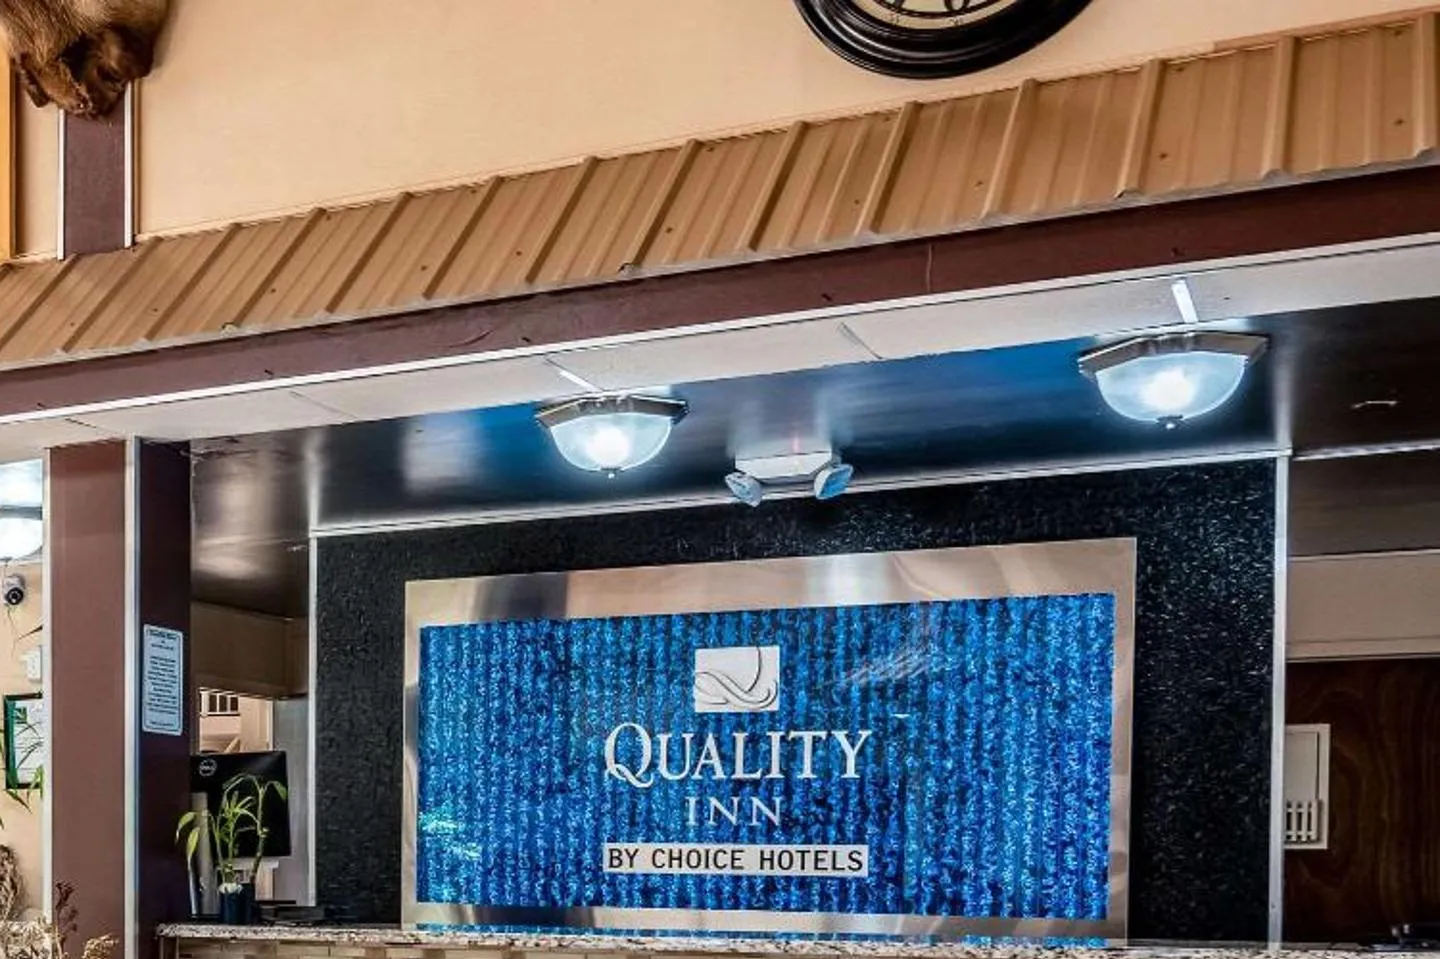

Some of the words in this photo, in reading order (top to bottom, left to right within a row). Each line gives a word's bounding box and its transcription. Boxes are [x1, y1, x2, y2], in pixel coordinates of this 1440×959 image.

[604, 722, 872, 788] QUALITY
[684, 796, 782, 826] INN
[608, 848, 639, 869] BY
[651, 848, 745, 871] CHOICE
[759, 849, 864, 872] HOTELS
